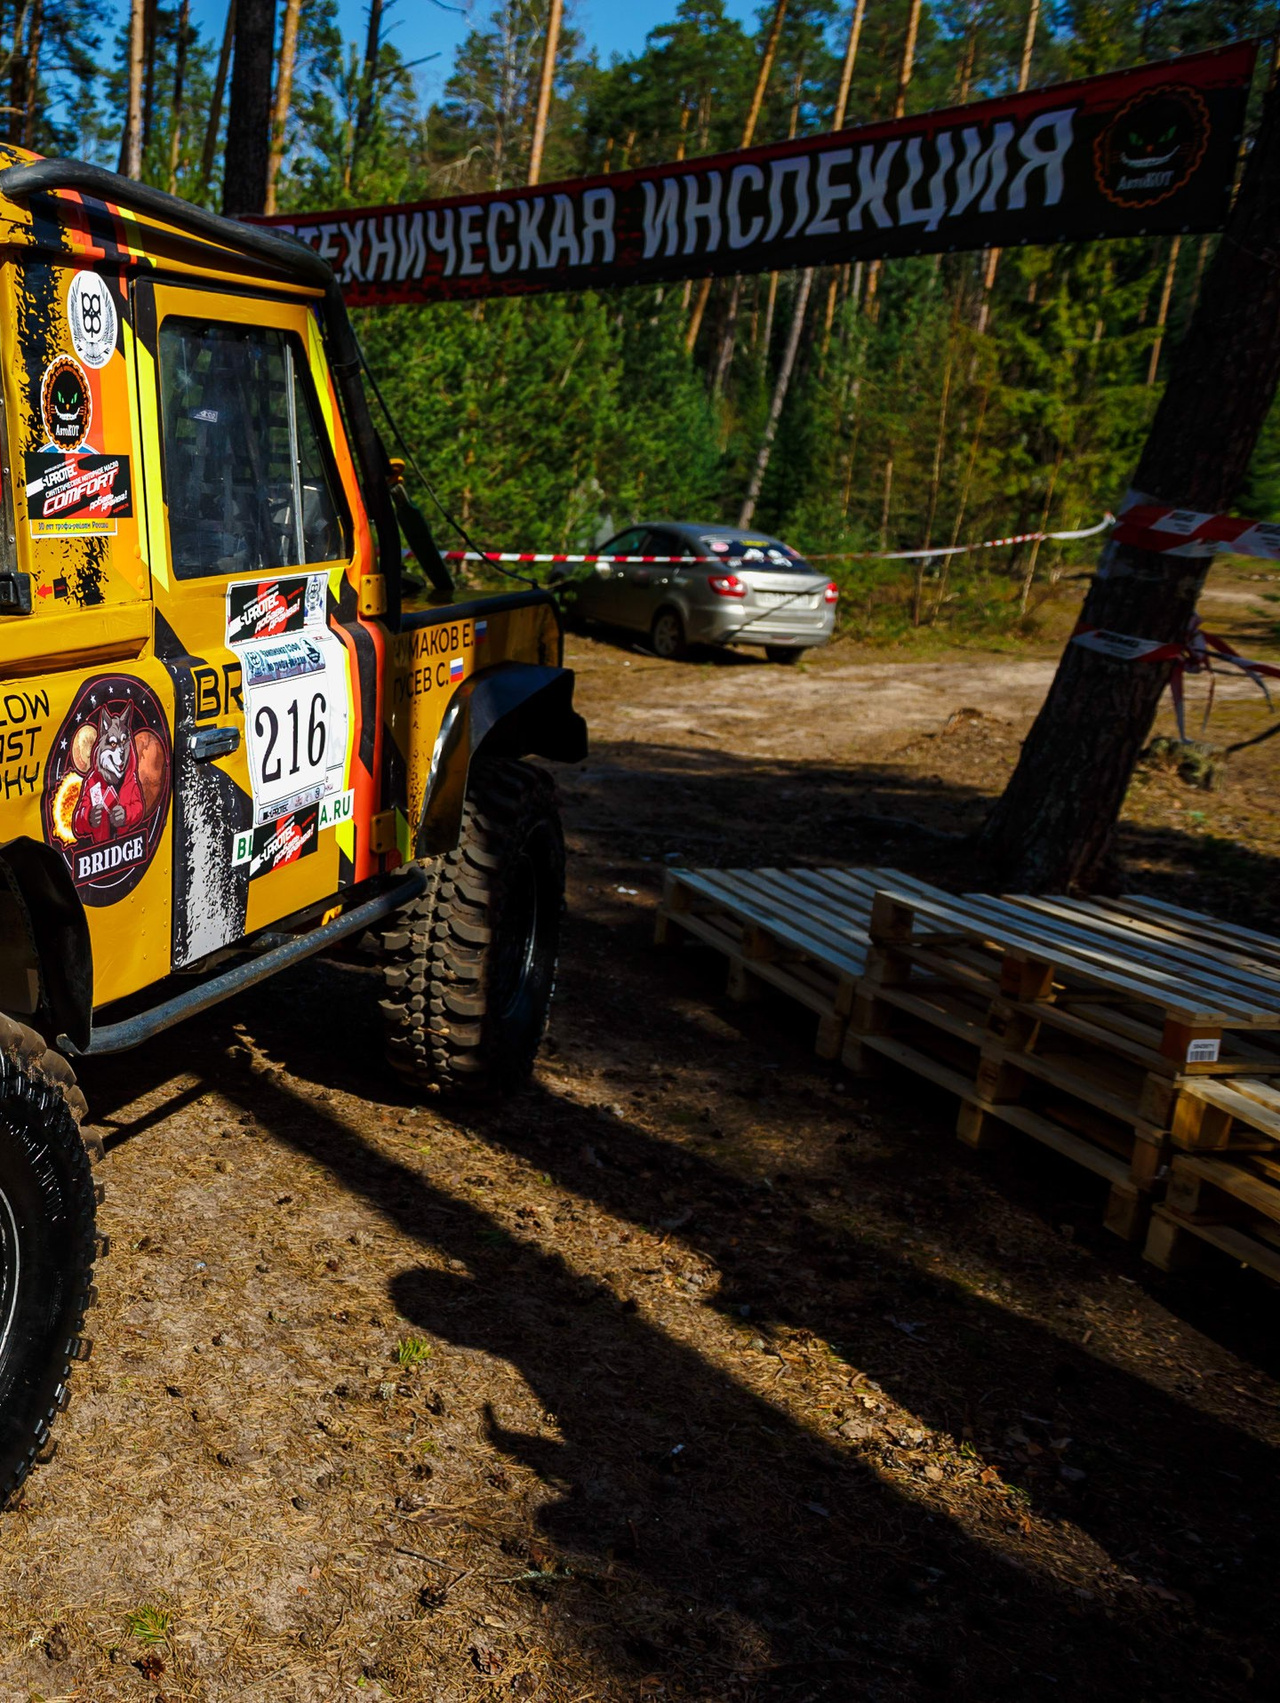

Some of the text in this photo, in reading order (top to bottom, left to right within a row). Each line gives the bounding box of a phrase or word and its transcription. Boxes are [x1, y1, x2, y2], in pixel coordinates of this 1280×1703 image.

[276, 107, 1078, 284] ТЕХНИЧЕСКАЯ ИНСПЕКЦИЯ
[43, 469, 118, 516] COMFORT
[463, 623, 474, 648] Е.
[436, 662, 449, 687] С.
[255, 692, 327, 784] 216
[78, 836, 144, 879] BRIDGE
